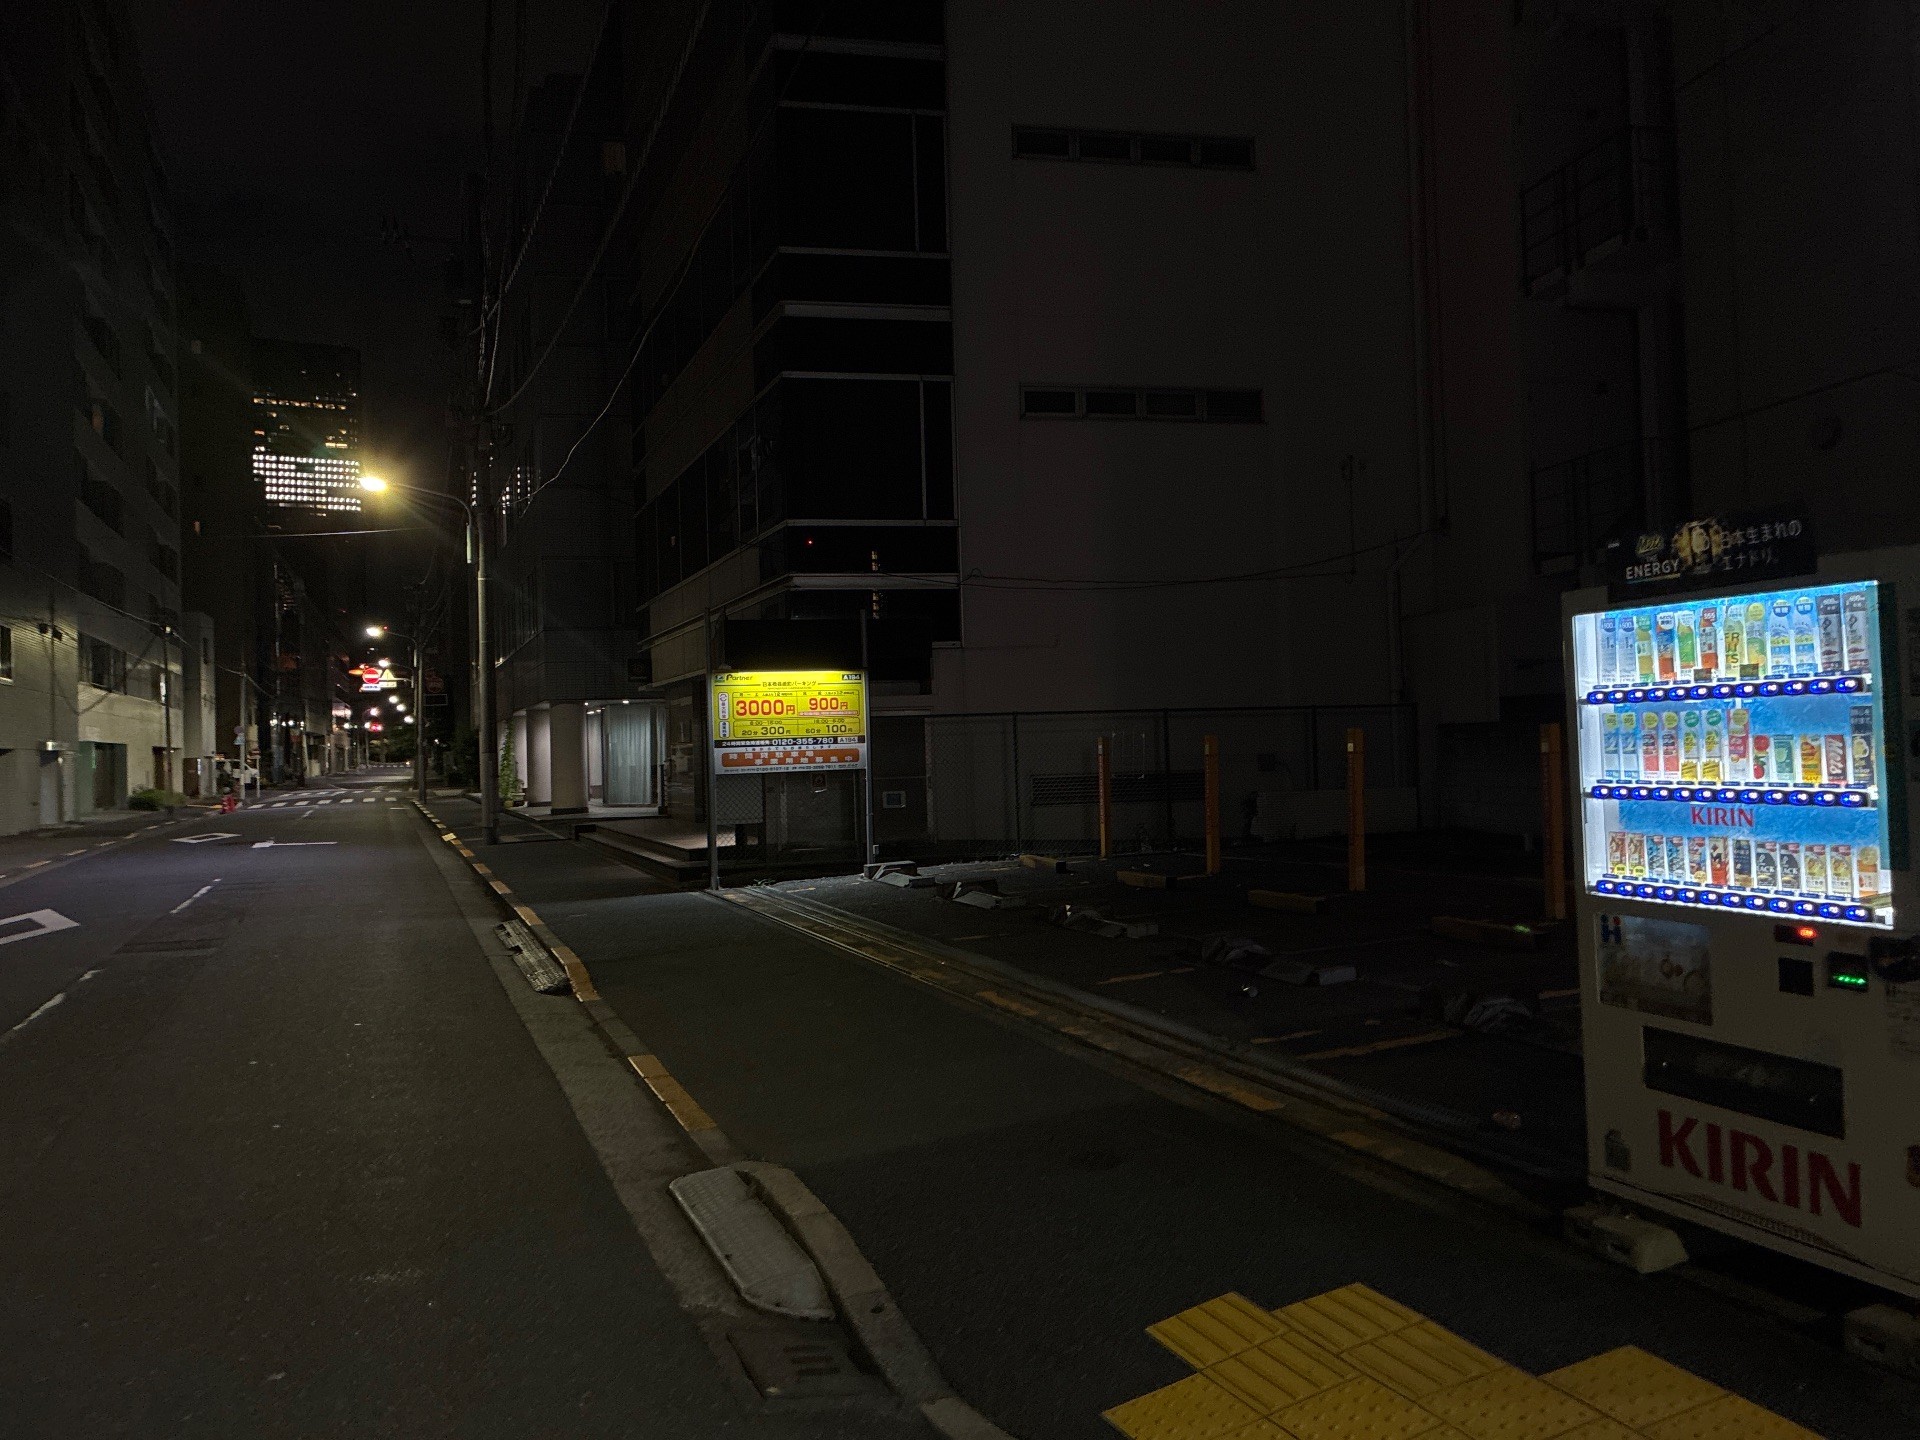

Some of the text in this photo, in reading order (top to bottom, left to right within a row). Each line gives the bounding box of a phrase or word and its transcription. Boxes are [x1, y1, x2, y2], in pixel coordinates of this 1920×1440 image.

[1625, 558, 1680, 580] ENERGY
[726, 673, 753, 681] Partner
[735, 699, 796, 717] 3000円
[808, 697, 849, 711] 900円
[761, 726, 791, 735] 300円
[825, 724, 853, 733] 100円
[1690, 805, 1755, 828] KIRIN
[1658, 1109, 1863, 1229] KIRIN
